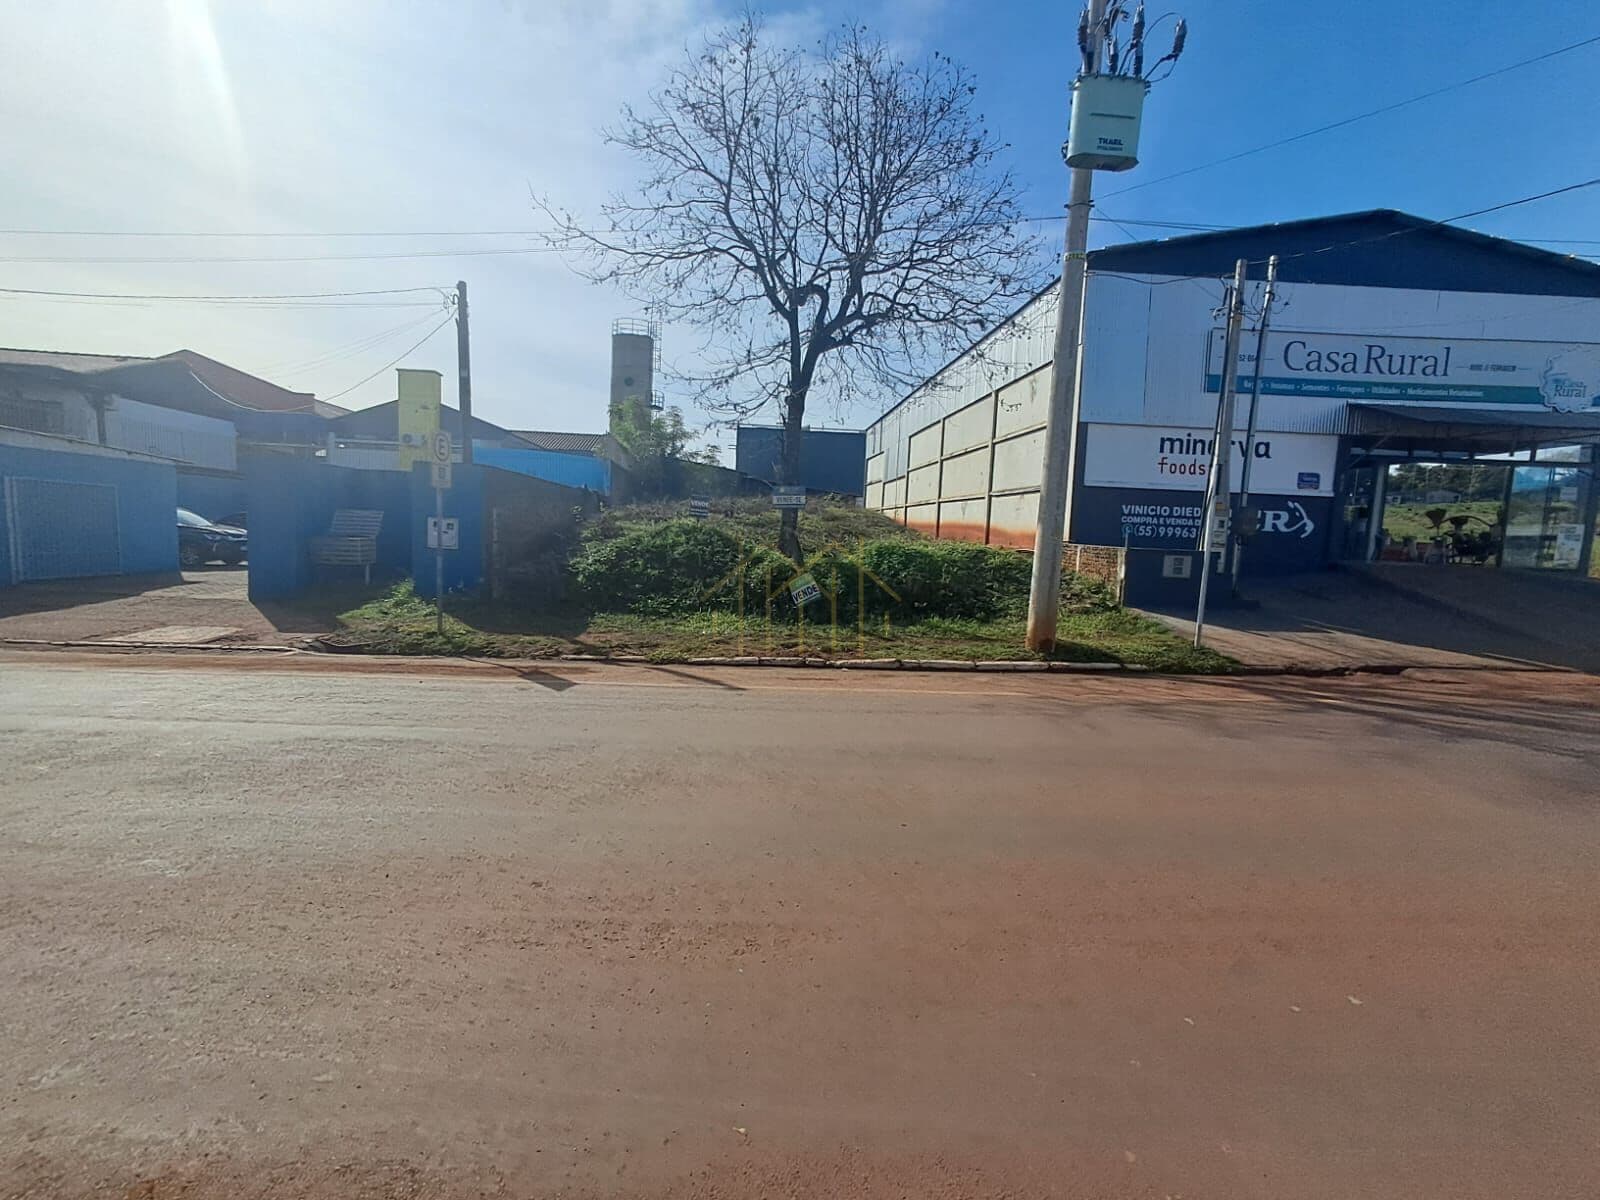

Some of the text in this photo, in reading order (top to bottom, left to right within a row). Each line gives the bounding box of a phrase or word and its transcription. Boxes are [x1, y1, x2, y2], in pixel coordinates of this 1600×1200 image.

[1284, 340, 1451, 377] Casa Rural
[1157, 457, 1206, 476] foods
[1121, 504, 1169, 516] VINICIO
[1121, 516, 1157, 525] COMPRA
[1165, 518, 1194, 527] VENDA
[792, 583, 819, 602] VENDE
